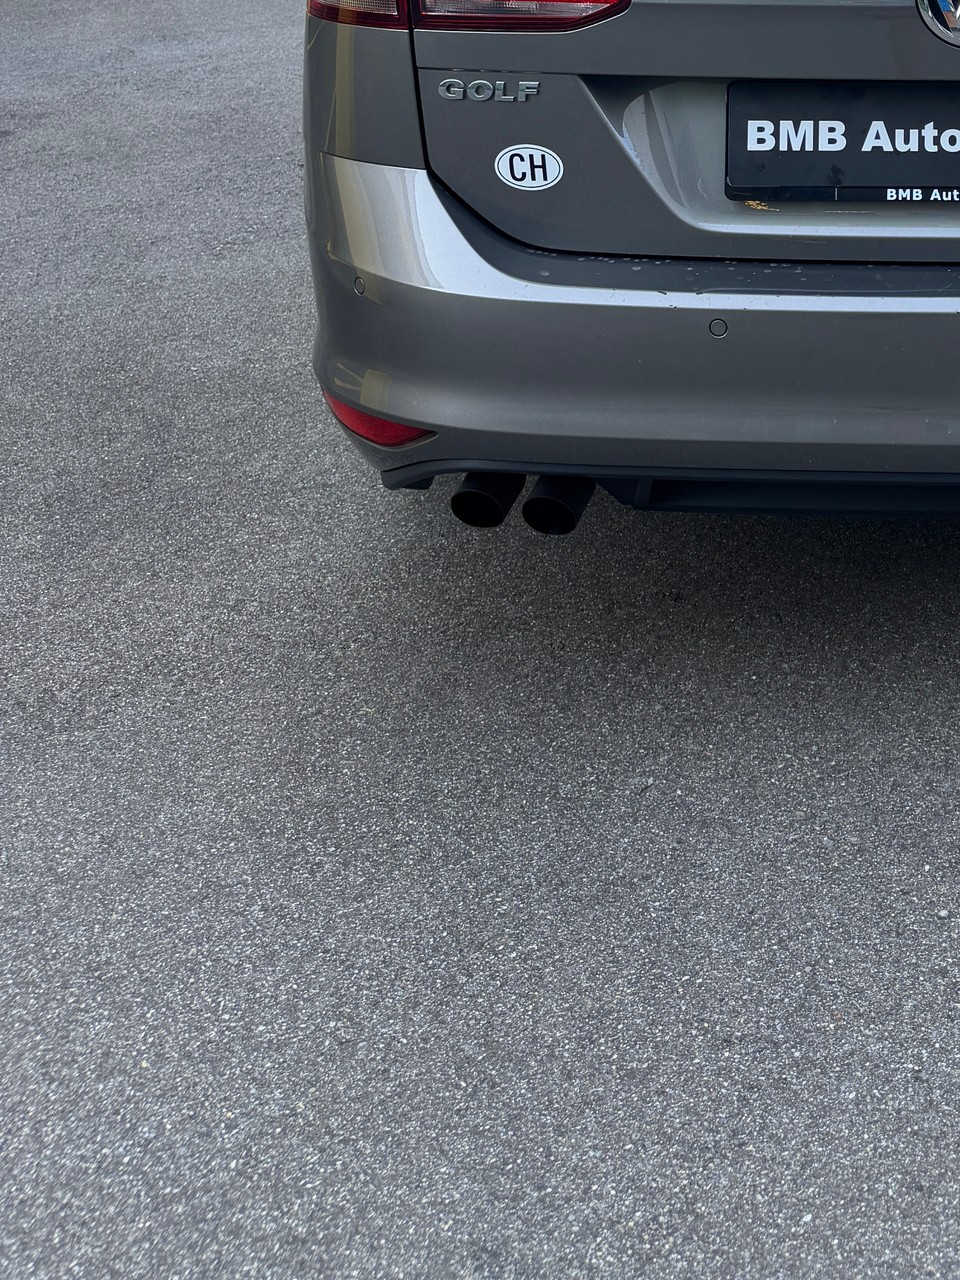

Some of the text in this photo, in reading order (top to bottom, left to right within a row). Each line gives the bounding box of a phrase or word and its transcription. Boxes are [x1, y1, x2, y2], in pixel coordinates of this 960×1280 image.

[438, 78, 541, 102] GOLF
[746, 120, 848, 153] BMB
[508, 152, 549, 182] CH
[886, 188, 924, 202] BMB
